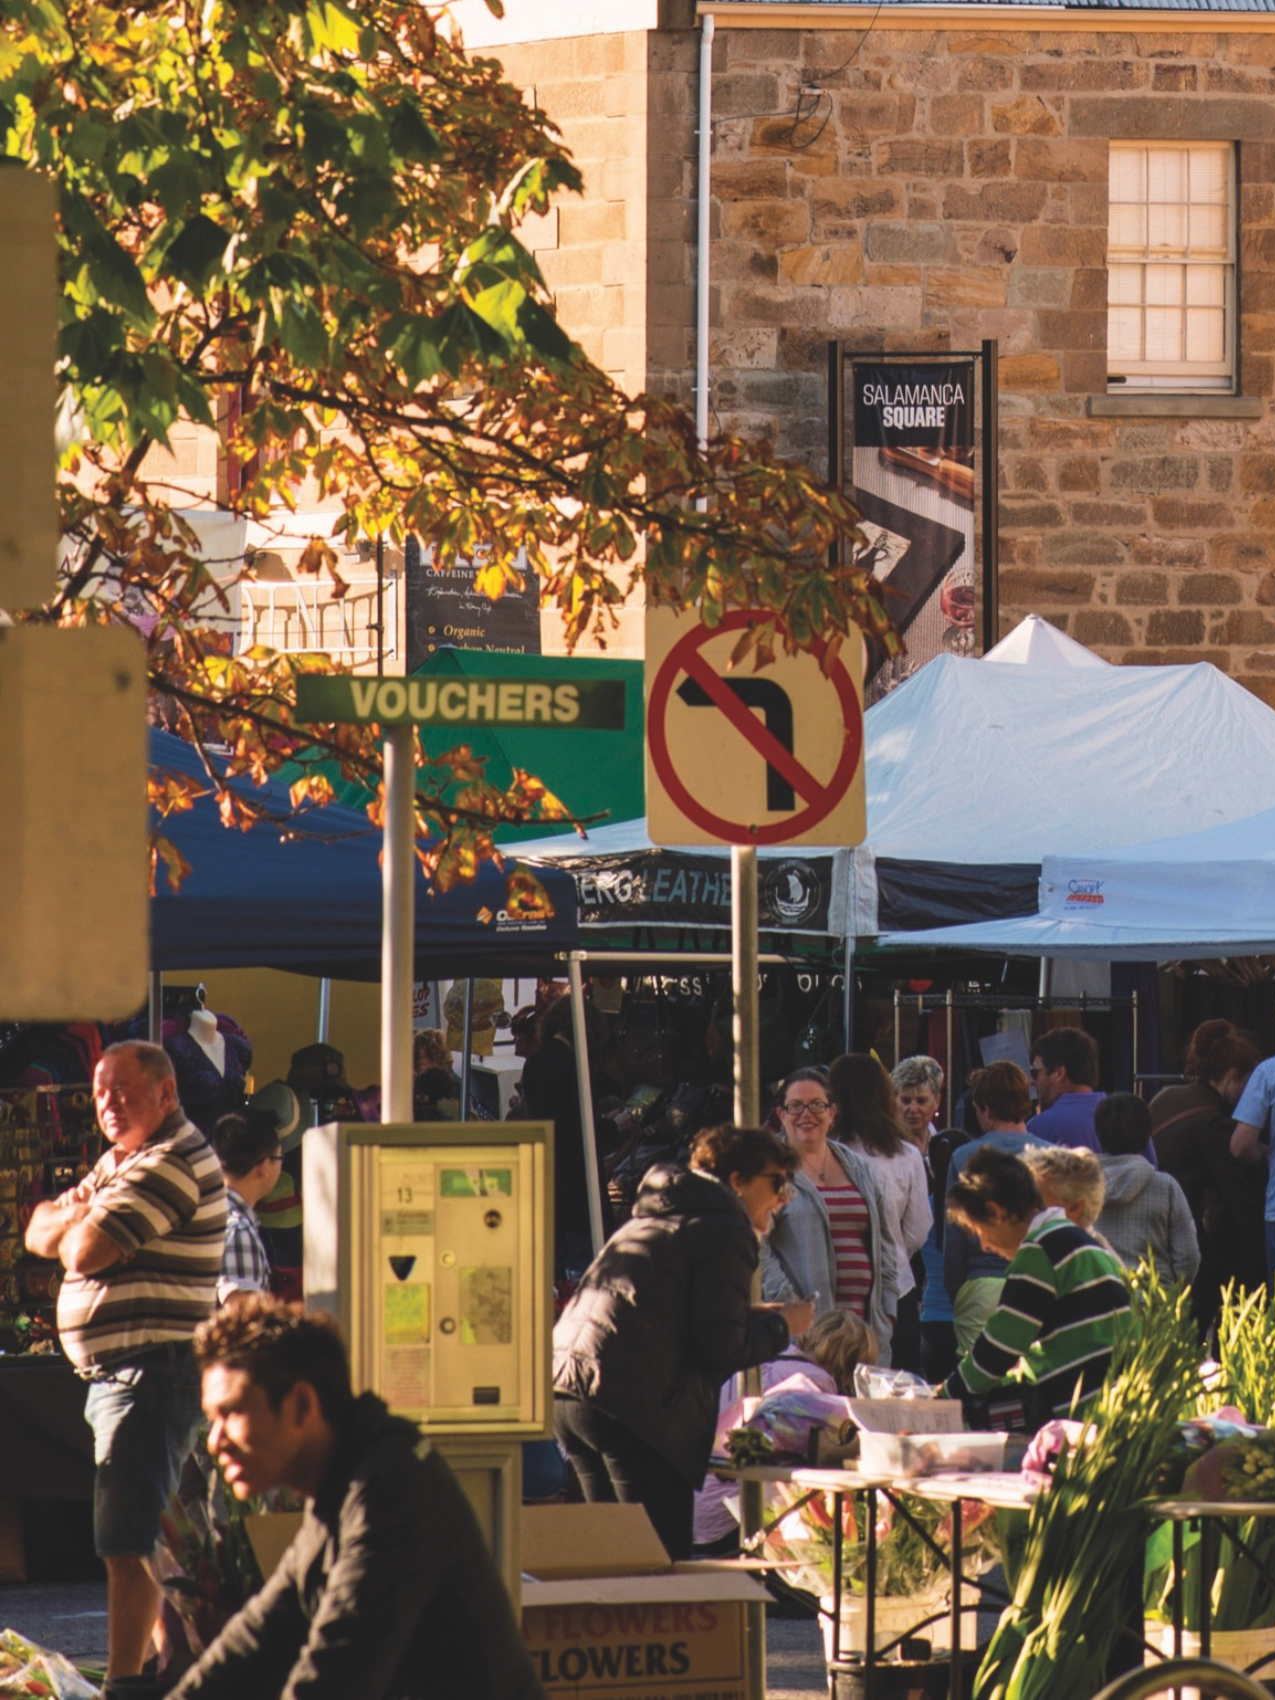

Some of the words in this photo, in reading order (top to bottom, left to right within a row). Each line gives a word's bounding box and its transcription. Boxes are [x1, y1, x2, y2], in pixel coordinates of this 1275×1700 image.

[863, 384, 965, 406] SALAMANCA
[883, 406, 945, 430] SQUARE
[443, 624, 486, 639] Organic
[350, 680, 581, 723] VOUCHERS
[572, 868, 634, 905] ERG
[397, 1186, 413, 1204] 13
[545, 1600, 719, 1641] FLOWERS
[532, 1641, 691, 1683] LOWERS
